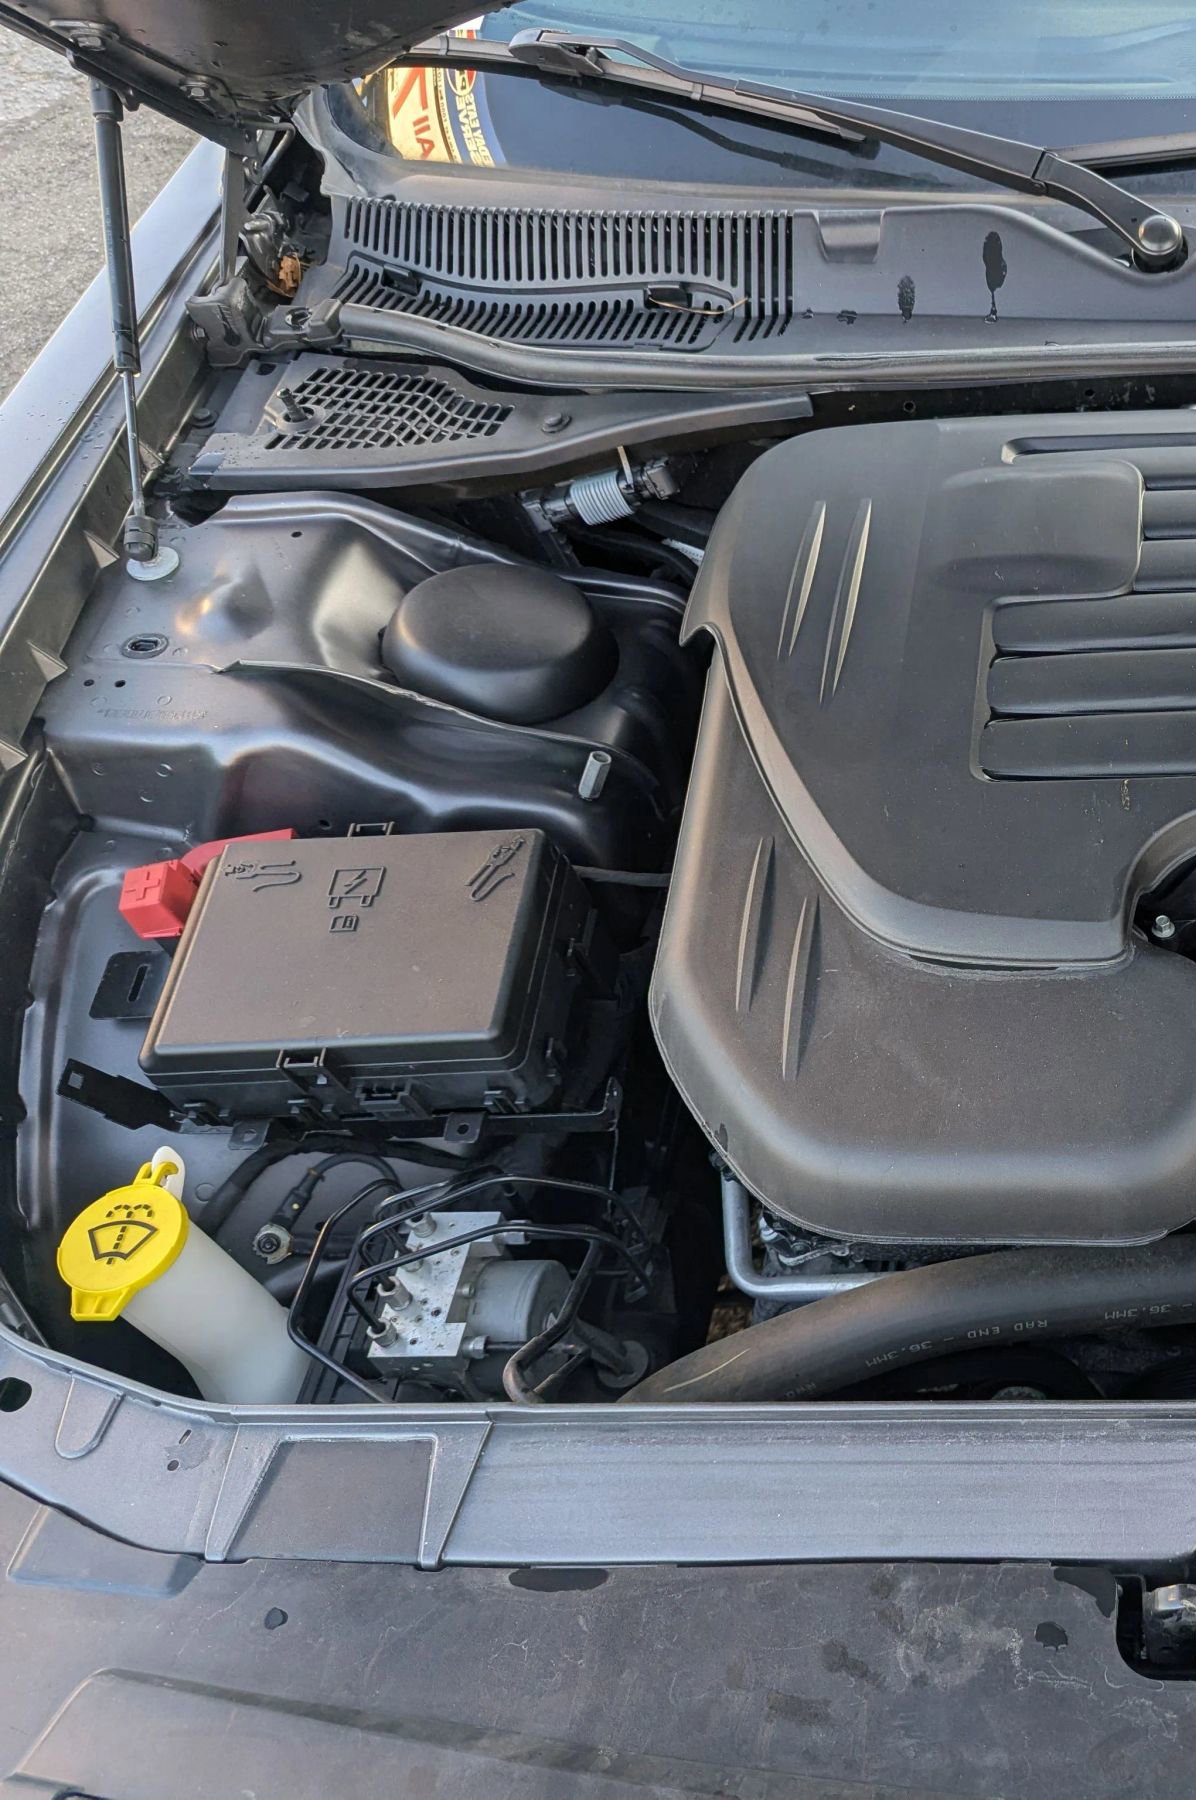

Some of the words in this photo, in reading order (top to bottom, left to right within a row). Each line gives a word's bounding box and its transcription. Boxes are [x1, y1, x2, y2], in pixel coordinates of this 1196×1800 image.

[1104, 1303, 1171, 1320] 36.3MM
[966, 1326, 1001, 1339] END
[1013, 1319, 1048, 1332] RAD
[864, 1340, 934, 1368] 36.3MM
